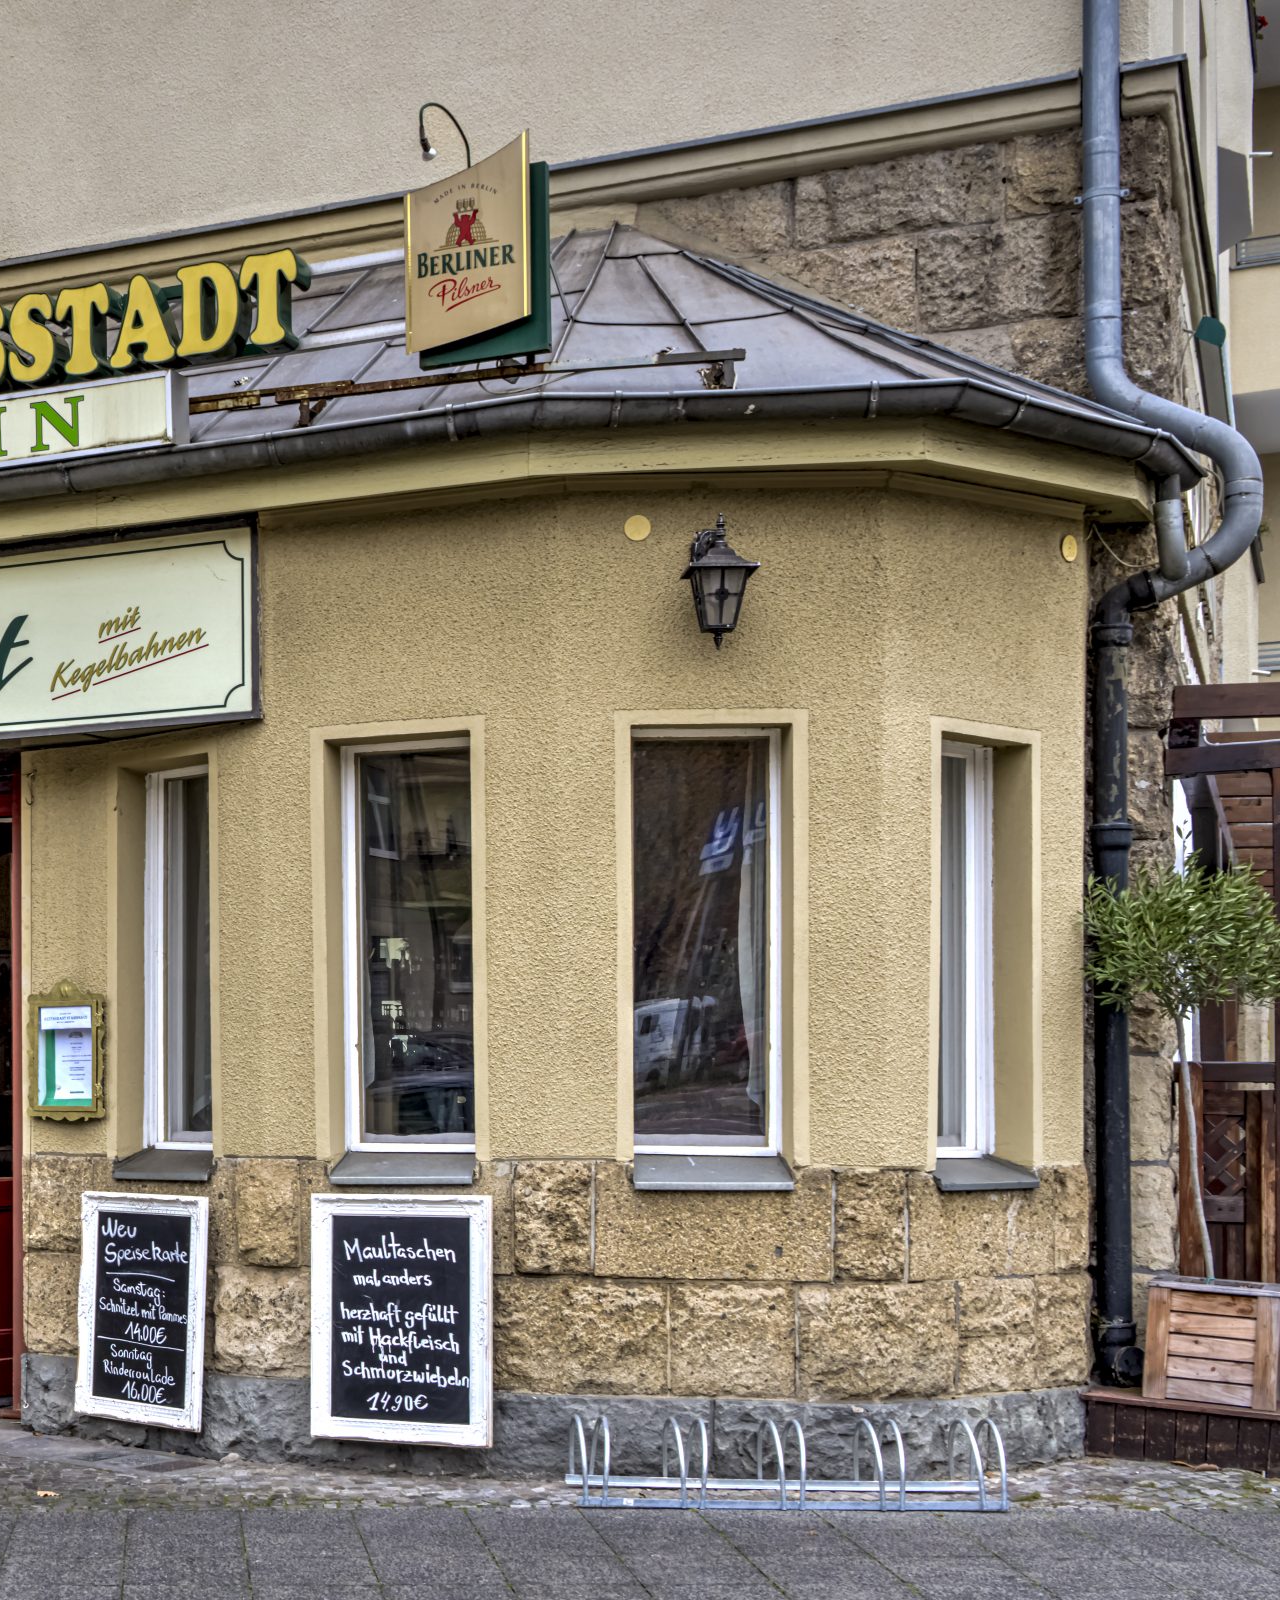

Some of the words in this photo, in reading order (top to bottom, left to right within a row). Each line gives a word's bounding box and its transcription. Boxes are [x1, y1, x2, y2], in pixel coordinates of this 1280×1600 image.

[433, 188, 453, 204] MADE
[470, 182, 497, 195] BERLIN
[417, 244, 515, 279] BERLINER
[428, 276, 501, 309] Pilsner
[98, 605, 141, 639] mit
[50, 626, 207, 693] Kegelbahnen
[102, 1216, 137, 1238] Neu
[343, 1231, 456, 1263] Maultaschen
[113, 1277, 166, 1307] Samstag:
[353, 1268, 381, 1287] mal
[382, 1268, 433, 1287] anders
[99, 1296, 140, 1317] Schnitzel
[141, 1302, 157, 1321] mit
[159, 1305, 188, 1325] Pommes
[340, 1301, 402, 1328] herzhaft
[404, 1302, 460, 1331] gefüllt
[341, 1324, 365, 1345] mit
[369, 1326, 461, 1354] Hackfleisch
[110, 1343, 153, 1370] Sonntag
[378, 1349, 408, 1367] und
[103, 1358, 176, 1386] Rinderroulade
[342, 1360, 470, 1388] Schmorzwiebeln
